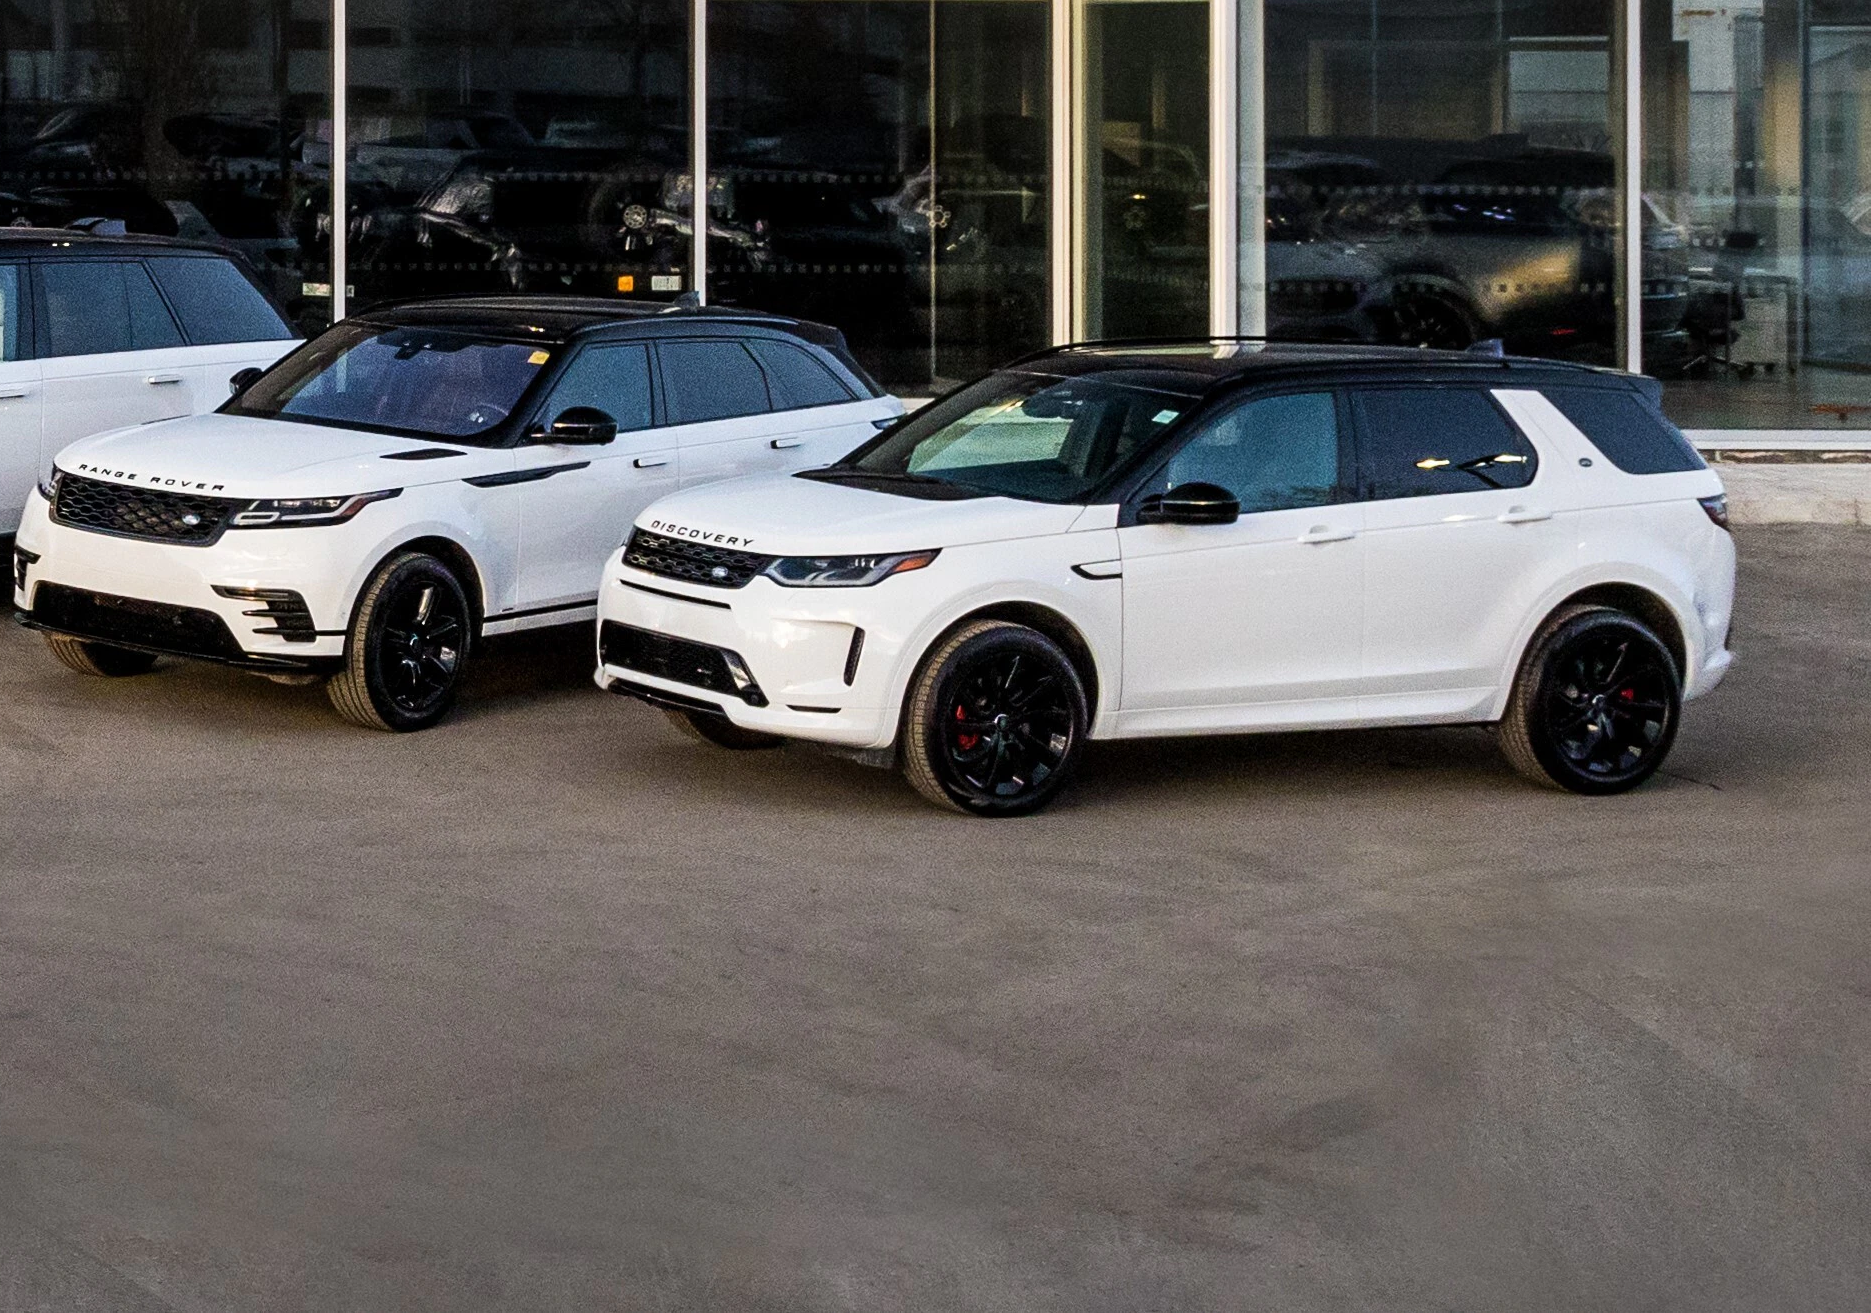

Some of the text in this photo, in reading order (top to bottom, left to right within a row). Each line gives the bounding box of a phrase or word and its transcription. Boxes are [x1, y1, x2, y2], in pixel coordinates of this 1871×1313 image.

[78, 463, 225, 491] RANGE ROVER
[651, 520, 754, 547] DISCOVERY
